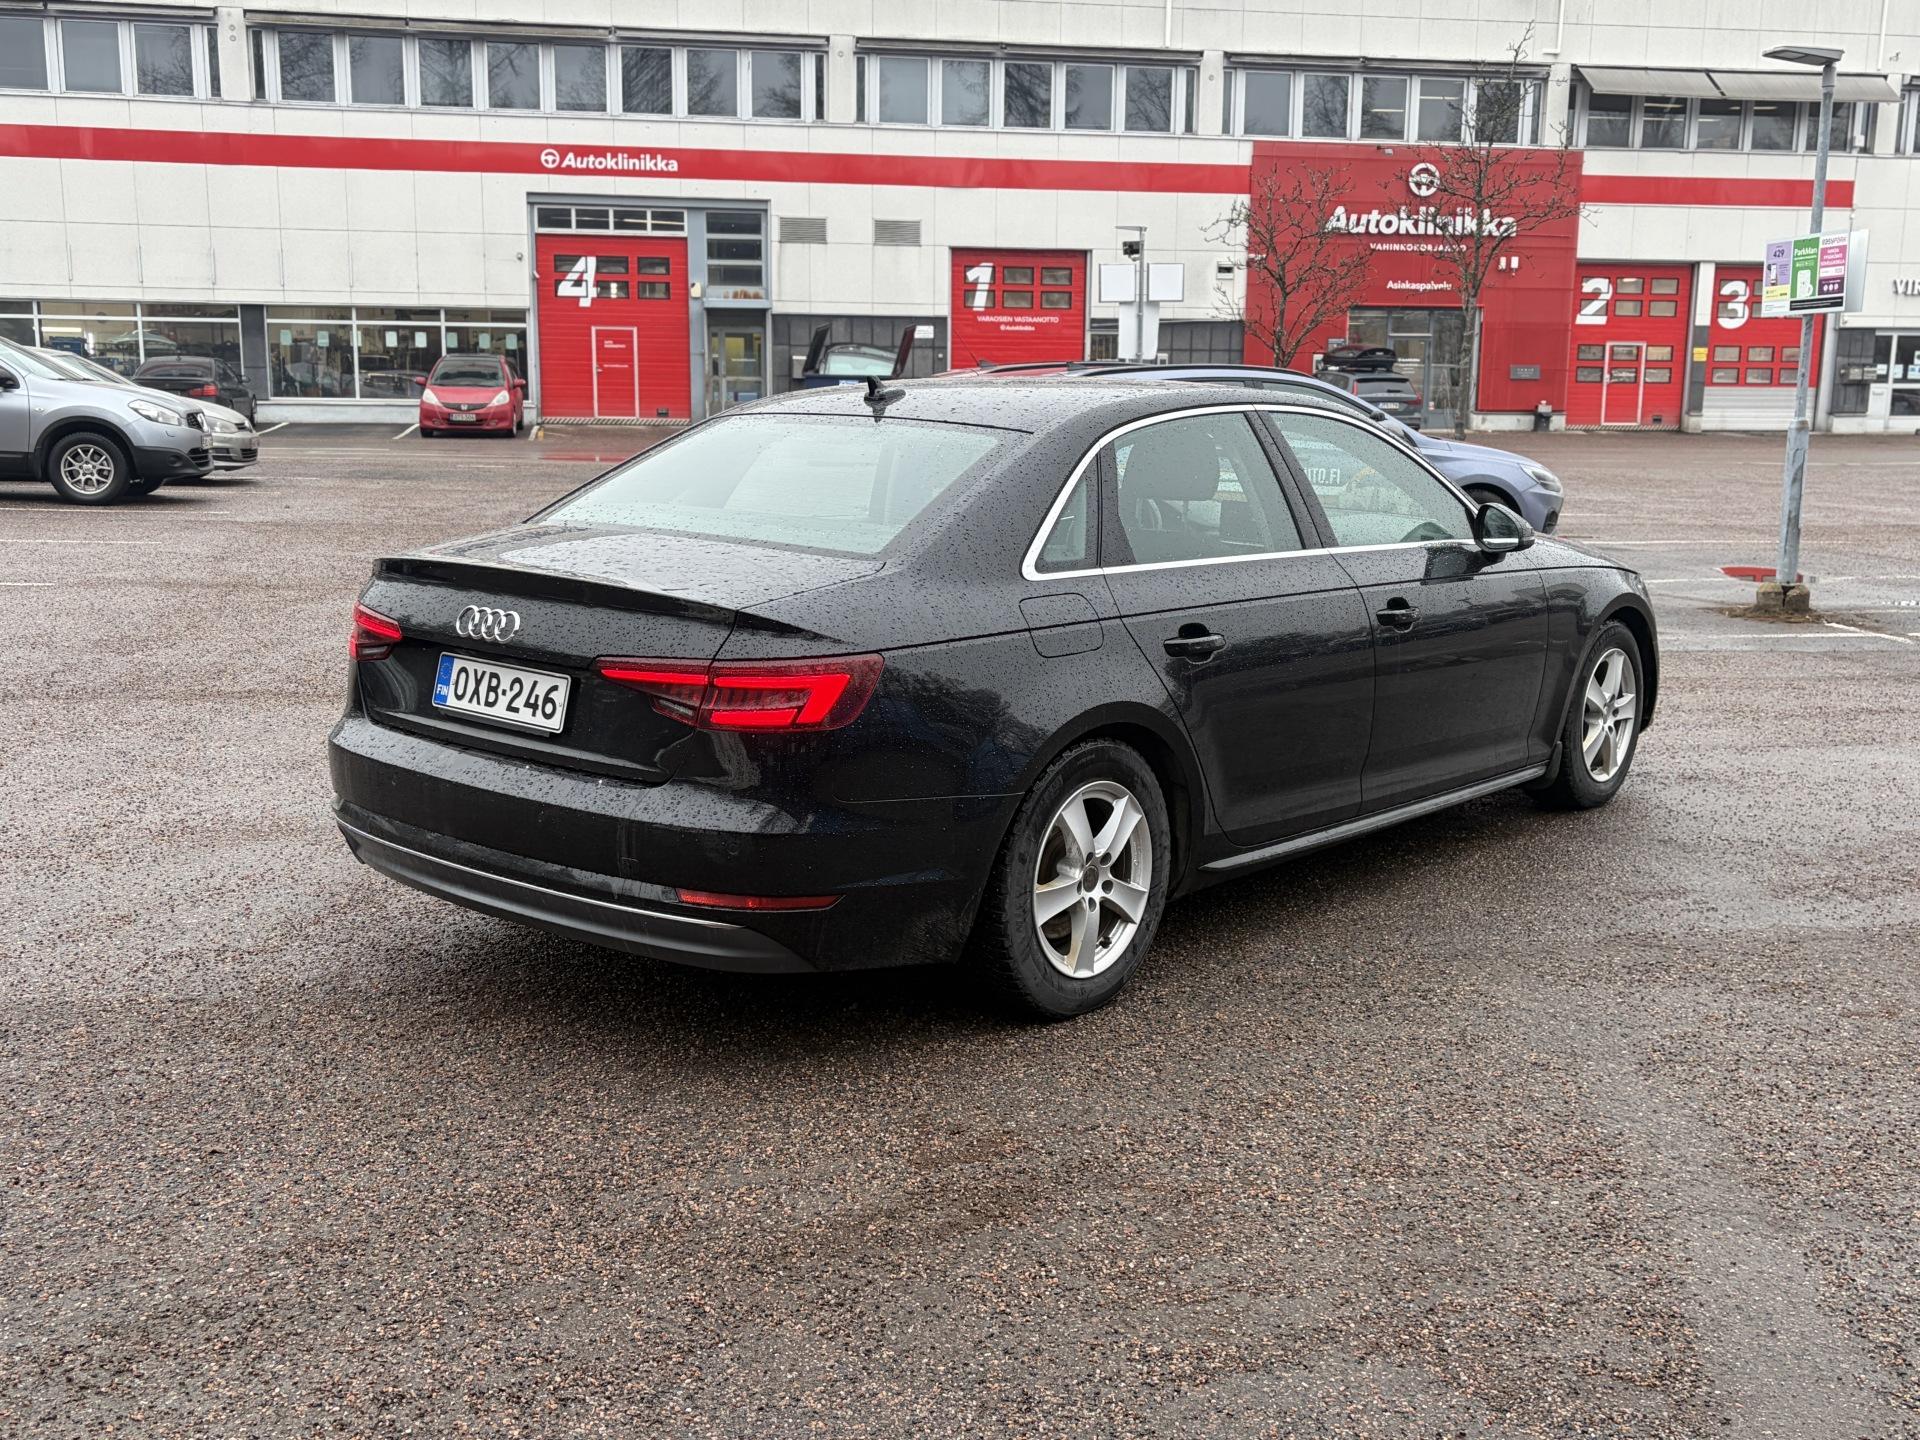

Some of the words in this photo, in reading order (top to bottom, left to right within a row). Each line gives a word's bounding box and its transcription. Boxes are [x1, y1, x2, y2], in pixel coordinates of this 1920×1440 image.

[561, 152, 679, 172] Autoklinikka
[1324, 205, 1517, 237] Autoklinikka
[1773, 249, 1785, 258] 429
[556, 256, 599, 307] 4
[966, 262, 994, 311] 1
[1575, 277, 1613, 325] 2
[1717, 280, 1750, 329] 3
[977, 315, 1013, 323] VARAOSIEN
[1014, 316, 1060, 324] VASTAANOTTO
[436, 684, 449, 696] FIN
[453, 666, 559, 720] OXB-246
